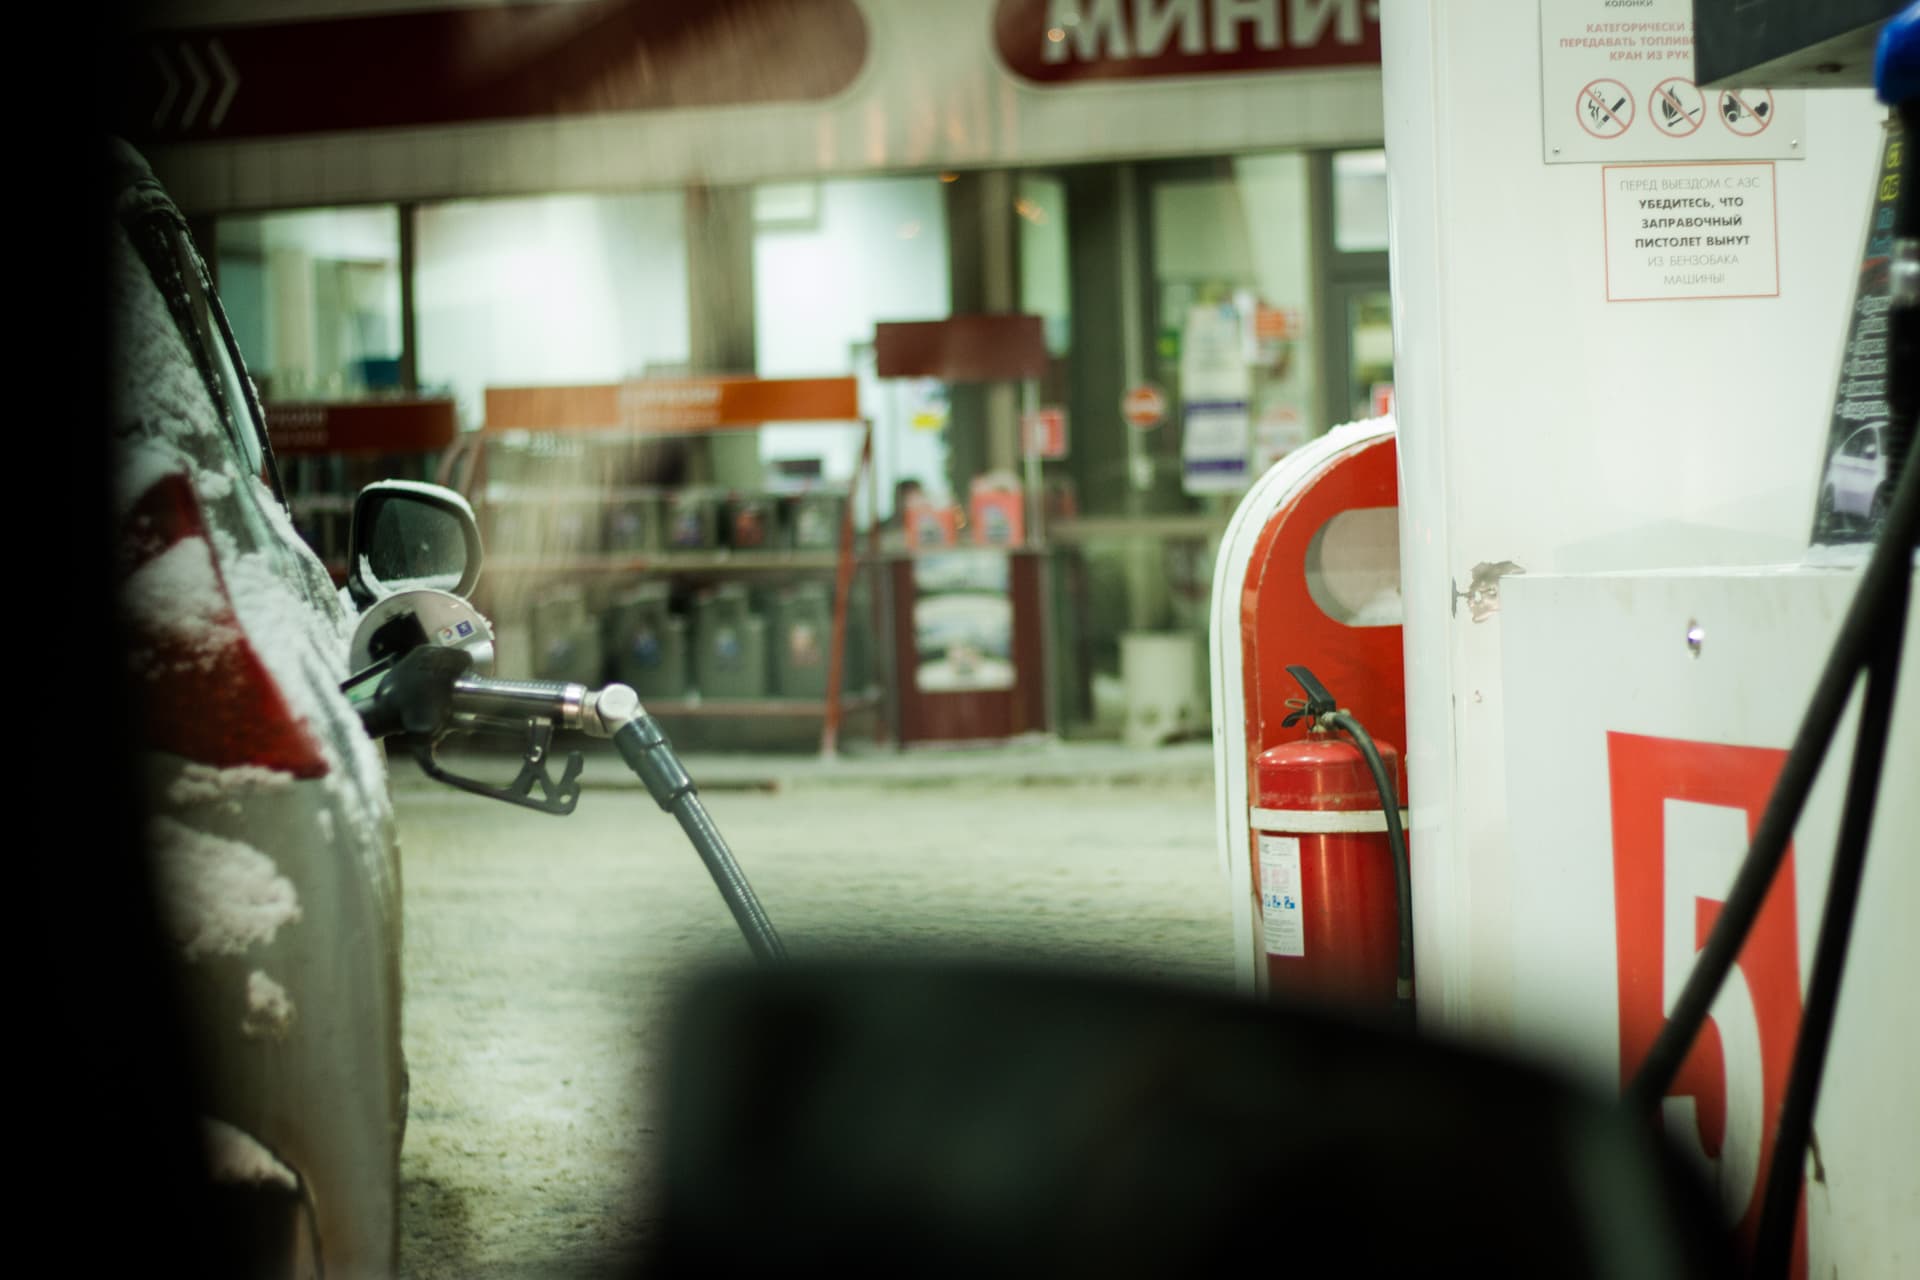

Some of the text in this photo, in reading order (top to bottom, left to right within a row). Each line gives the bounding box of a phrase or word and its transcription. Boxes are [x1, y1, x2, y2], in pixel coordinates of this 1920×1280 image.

[1586, 22, 1685, 33] КАТЕГОРИЧЕСКИ
[1559, 37, 1636, 48] ПЕРЕДАВАТЬ
[1609, 50, 1689, 61] КРАН ИЗ РУК
[1620, 177, 1760, 192] ПЕРЕД ВЫЕЗДОМ С АЗС
[1639, 196, 1744, 210] УБЕДИТЕСЬ, ЧТО
[1642, 214, 1742, 229] ЗАПРАВОЧНЫЙ
[1635, 235, 1750, 248] ПИСТОЛЕТ ВЫНУТ
[1648, 254, 1739, 267] ИЗ БЕНЗОБАКА
[1662, 797, 1764, 1235] 5
